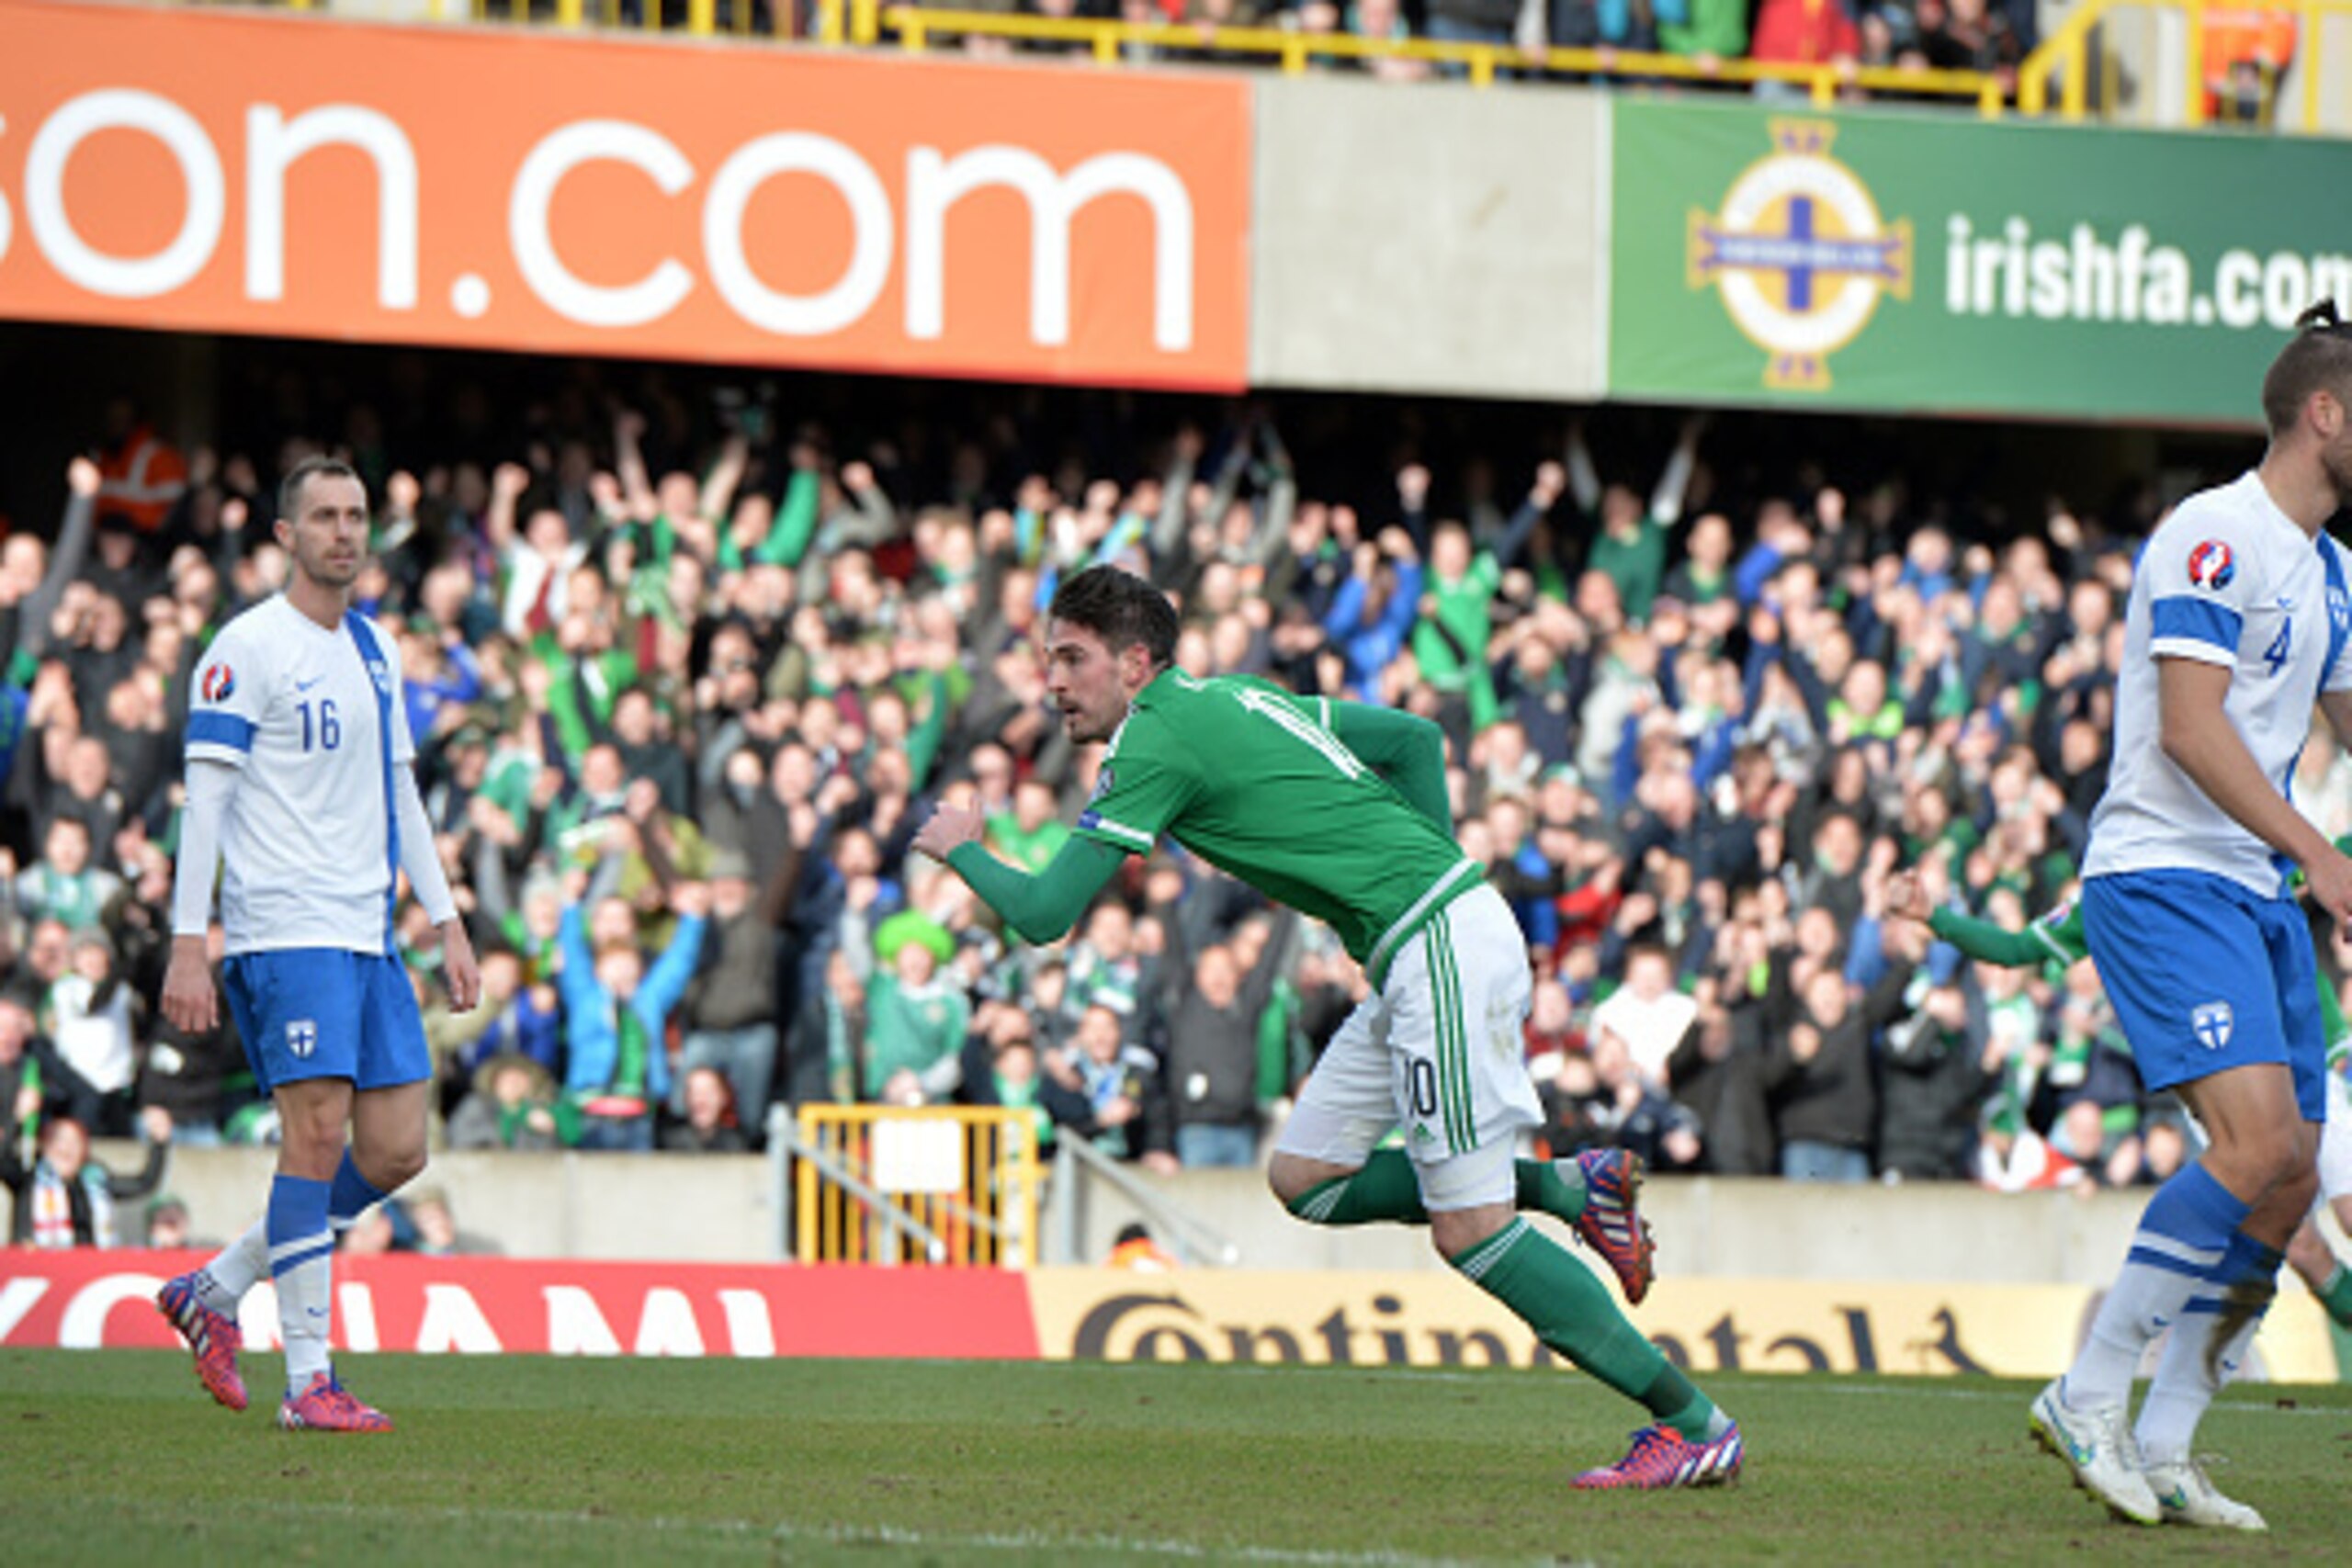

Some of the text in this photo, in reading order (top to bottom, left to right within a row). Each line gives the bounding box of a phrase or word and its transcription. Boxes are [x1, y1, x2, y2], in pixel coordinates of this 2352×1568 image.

[0, 86, 1193, 353] on.com
[2263, 615, 2291, 678] 4
[295, 698, 340, 752] 16
[0, 1272, 776, 1357] ONAMI
[1072, 1292, 1880, 1372] Contintal
